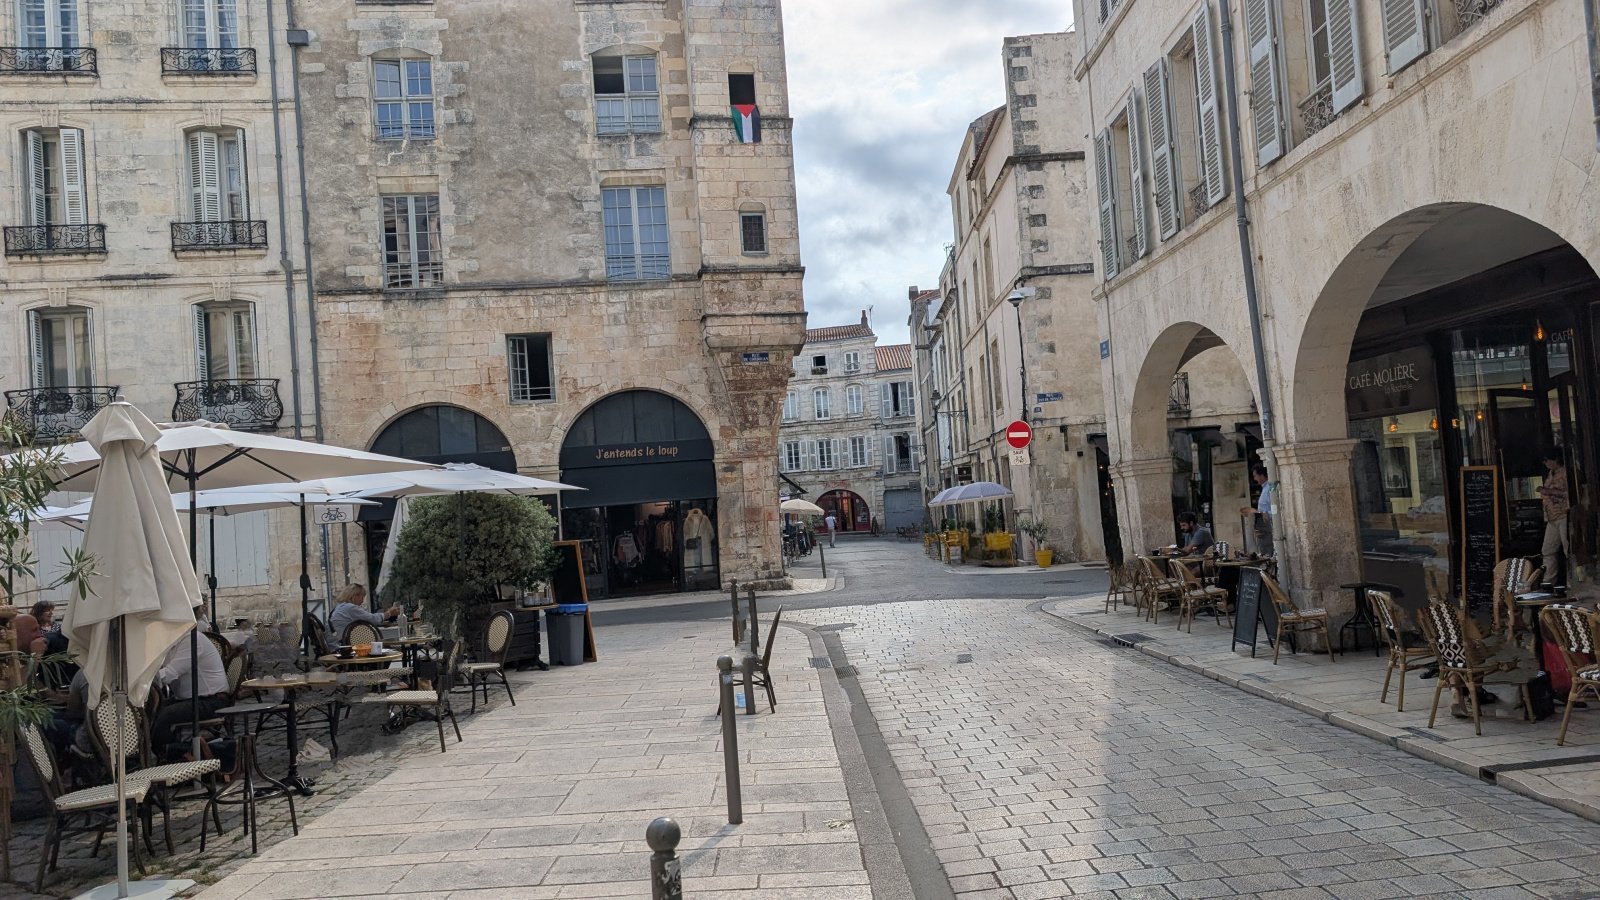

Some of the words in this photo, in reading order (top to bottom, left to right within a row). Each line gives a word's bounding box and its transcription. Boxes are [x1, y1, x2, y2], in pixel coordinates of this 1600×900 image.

[1349, 371, 1371, 390] CAFÉ
[1373, 363, 1419, 387] MOLIÈRE
[595, 447, 643, 459] J'entends
[646, 446, 655, 456] le
[658, 445, 678, 457] loup
